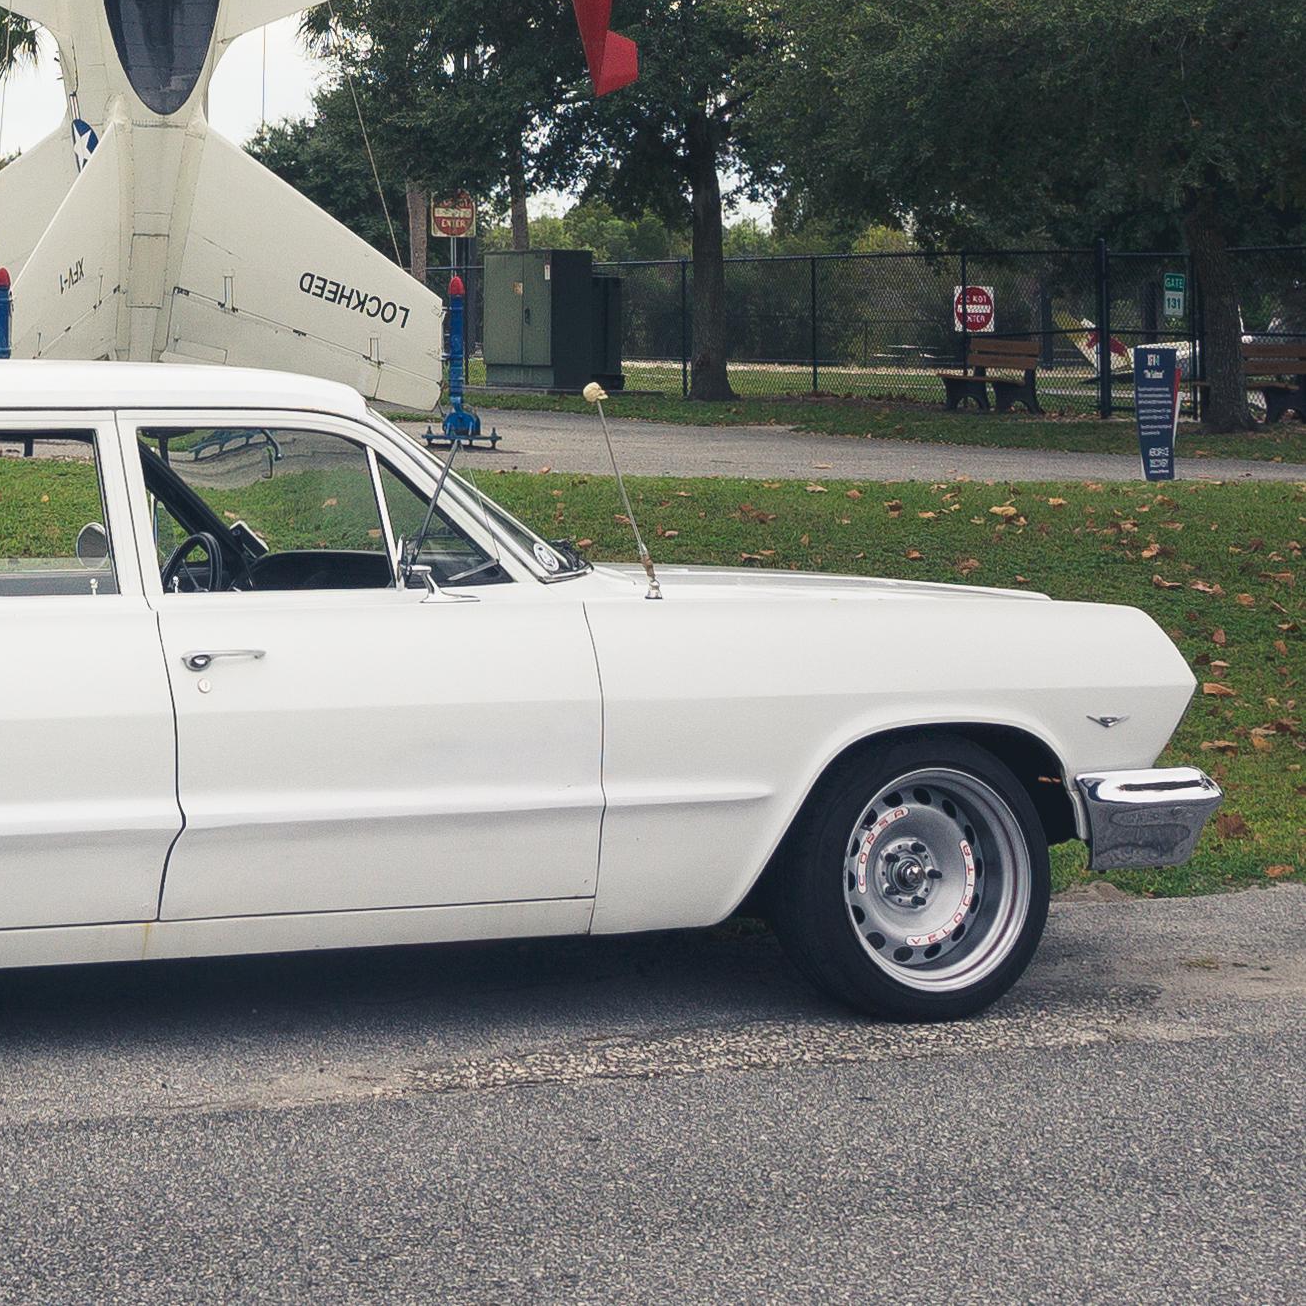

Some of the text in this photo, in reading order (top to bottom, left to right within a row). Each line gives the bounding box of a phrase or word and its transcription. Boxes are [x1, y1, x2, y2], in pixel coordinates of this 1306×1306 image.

[59, 256, 85, 295] XFV-1
[1164, 277, 1183, 289] GATE
[298, 271, 411, 329] LOCKHEED
[1166, 296, 1182, 310] 131
[858, 808, 906, 888] CORSA
[910, 844, 975, 945] VELOCITA
